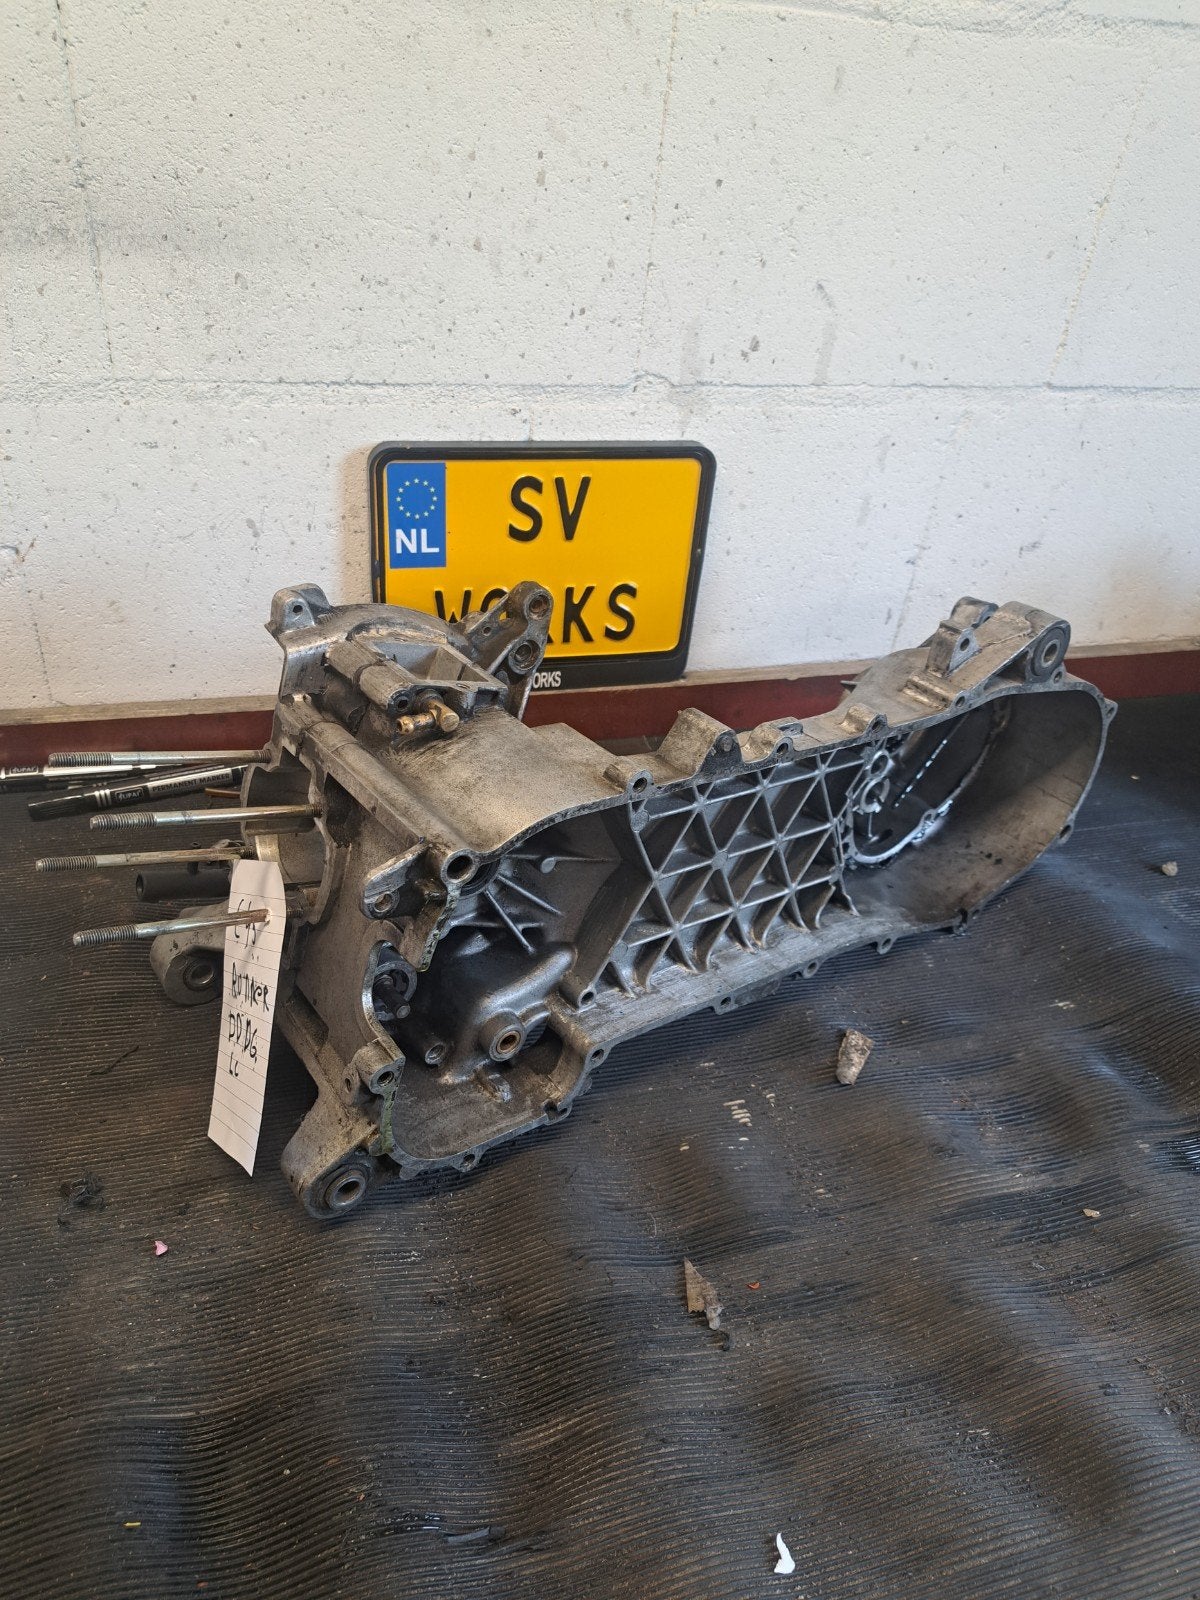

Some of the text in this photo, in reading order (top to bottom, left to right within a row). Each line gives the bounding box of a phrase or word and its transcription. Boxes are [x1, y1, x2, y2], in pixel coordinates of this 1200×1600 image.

[508, 474, 592, 542] SV
[395, 528, 440, 554] NL
[434, 582, 638, 645] WKS
[532, 670, 562, 689] ORKS
[152, 778, 198, 792] PERMANENT
[199, 773, 231, 785] MARKER
